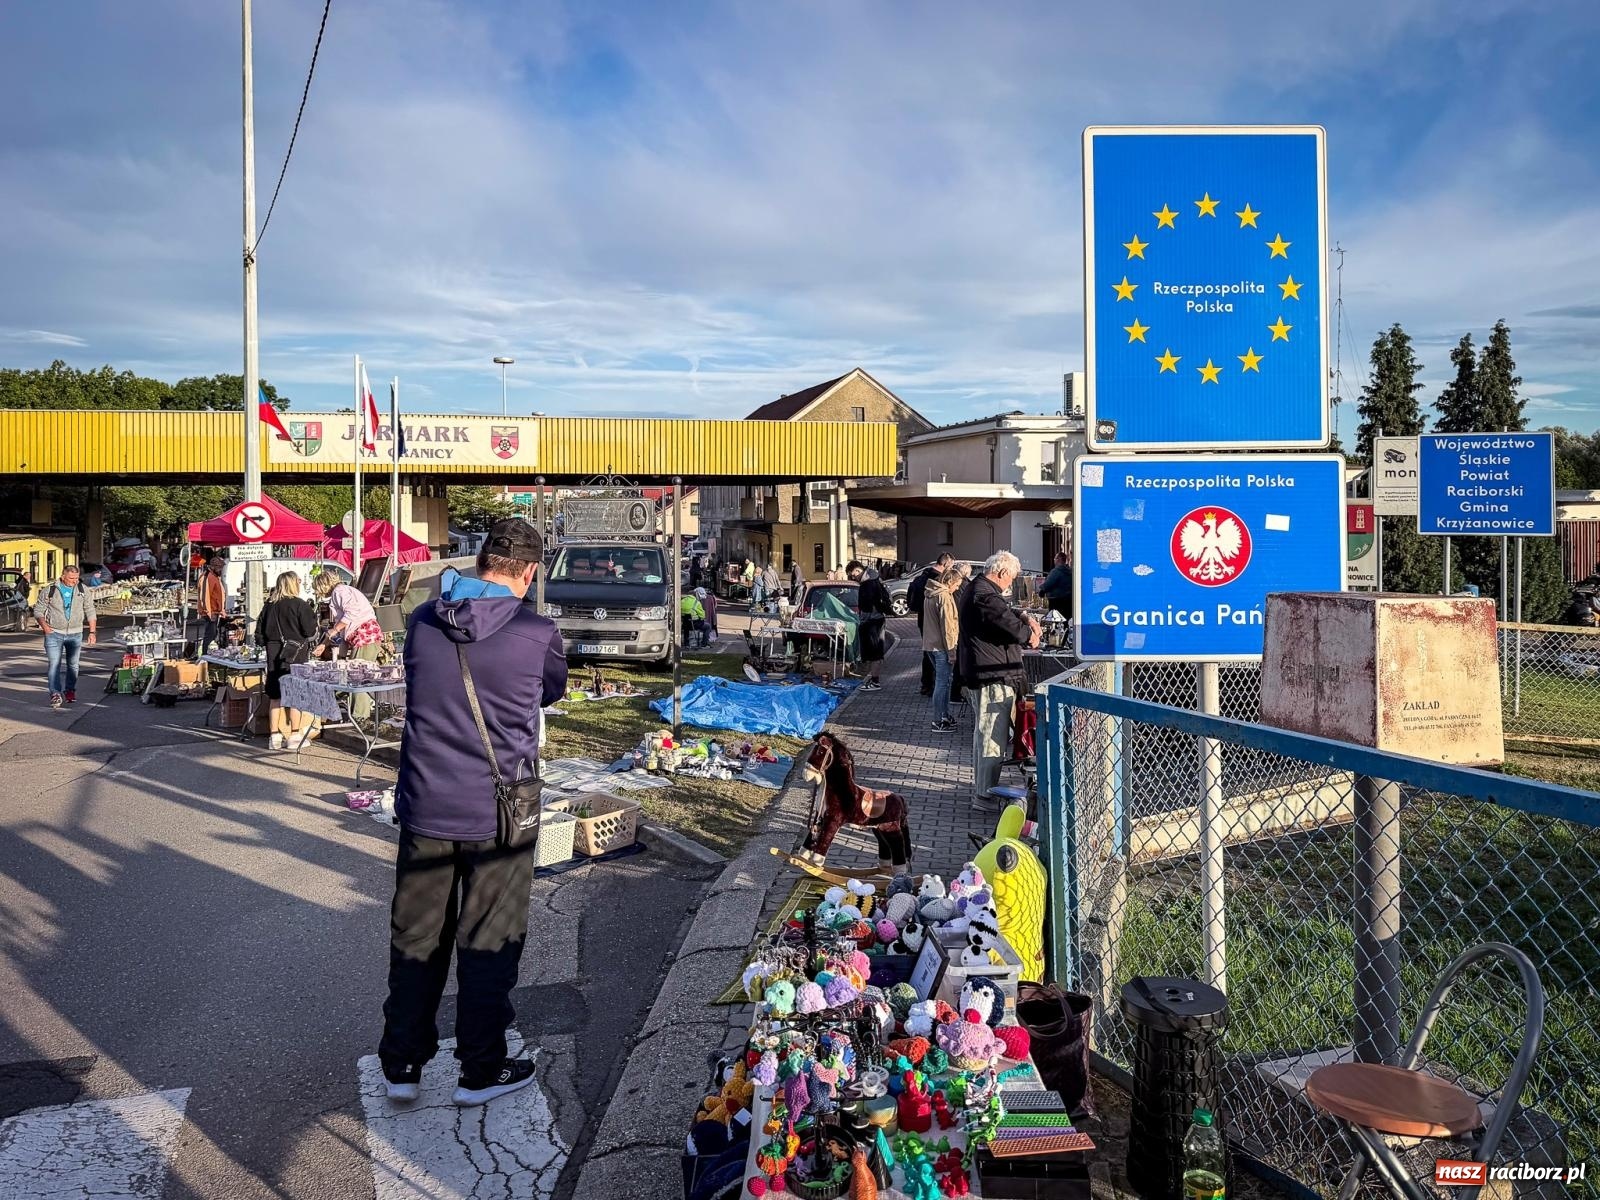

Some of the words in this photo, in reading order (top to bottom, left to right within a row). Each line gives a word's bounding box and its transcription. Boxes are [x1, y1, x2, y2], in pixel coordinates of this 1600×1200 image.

[1153, 281, 1265, 297] Rzeczpospolita
[1186, 299, 1234, 313] Polska
[1434, 438, 1536, 452] Województwo
[1458, 451, 1511, 467] Śląskie
[1460, 469, 1510, 481] Powiat
[1125, 475, 1241, 492] Rzeczpospolita
[1247, 474, 1295, 488] Polska
[1447, 485, 1524, 497] Raciborski
[1459, 501, 1509, 513] Gmina
[1436, 517, 1535, 531] Krzyżanowice
[1100, 604, 1205, 626] Granica
[1403, 700, 1440, 711] ZAKŁAD
